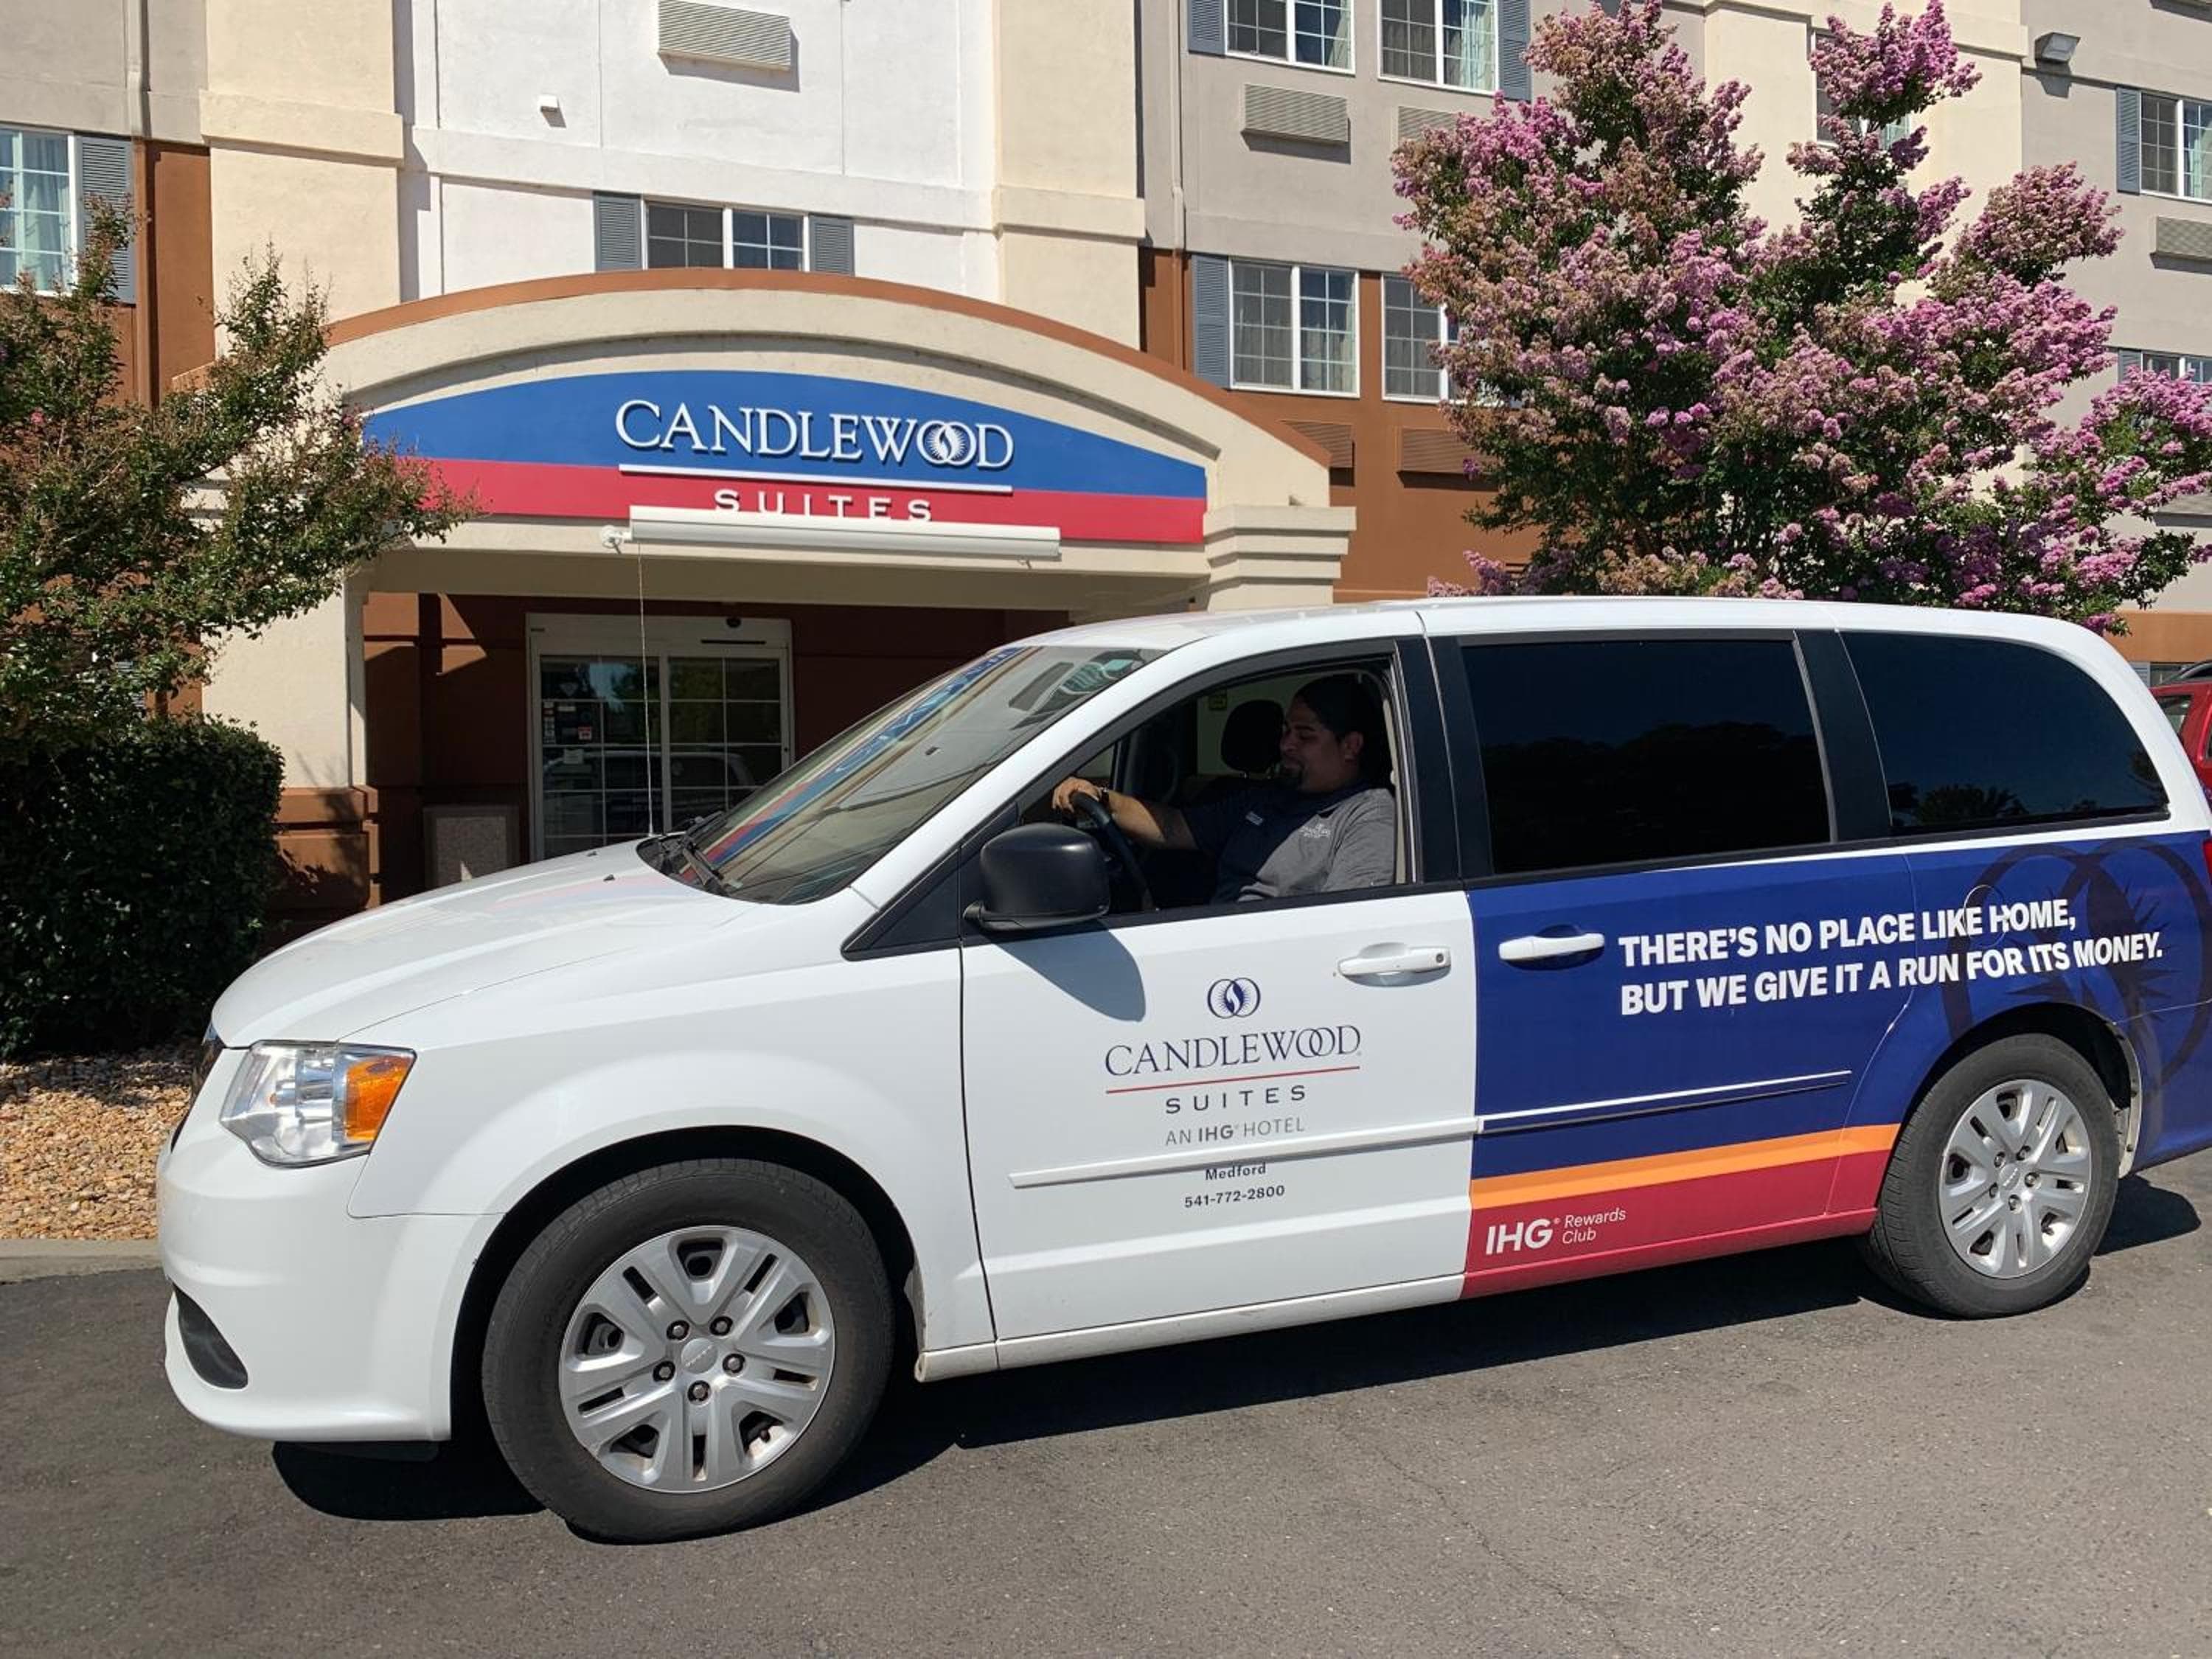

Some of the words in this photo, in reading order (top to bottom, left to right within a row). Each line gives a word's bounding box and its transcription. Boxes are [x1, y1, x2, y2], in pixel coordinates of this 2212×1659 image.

[615, 400, 1014, 469] CANDLEWOOD
[714, 489, 933, 522] SUITES
[1618, 927, 1759, 967] THERE'S
[1765, 922, 1812, 955] NO
[1820, 914, 1915, 950] PLACE
[1922, 905, 1983, 940] LIKE
[1989, 899, 2076, 933] HOME,
[1621, 980, 1689, 1016] BUT
[1696, 974, 1747, 1008] WE
[1754, 967, 1828, 1002] GIVE
[1835, 963, 1863, 993] IT
[1869, 960, 1892, 990] A
[1899, 954, 1959, 987] RUN
[1966, 947, 2027, 980] FOR
[2029, 942, 2070, 973] ITS
[2073, 931, 2163, 967] MONEY.
[1105, 1025, 1361, 1076] CANDLEWOOD
[1166, 1085, 1306, 1114] SUITES
[1166, 1129, 1192, 1147] AN
[1198, 1124, 1234, 1143] IHG
[1244, 1116, 1305, 1138] HOTEL
[1205, 1161, 1266, 1180] Medford
[1184, 1185, 1285, 1208] 541-772-2800
[1564, 1207, 1627, 1229] Rewards
[1486, 1218, 1554, 1255] IHG
[1562, 1227, 1596, 1245] Club
